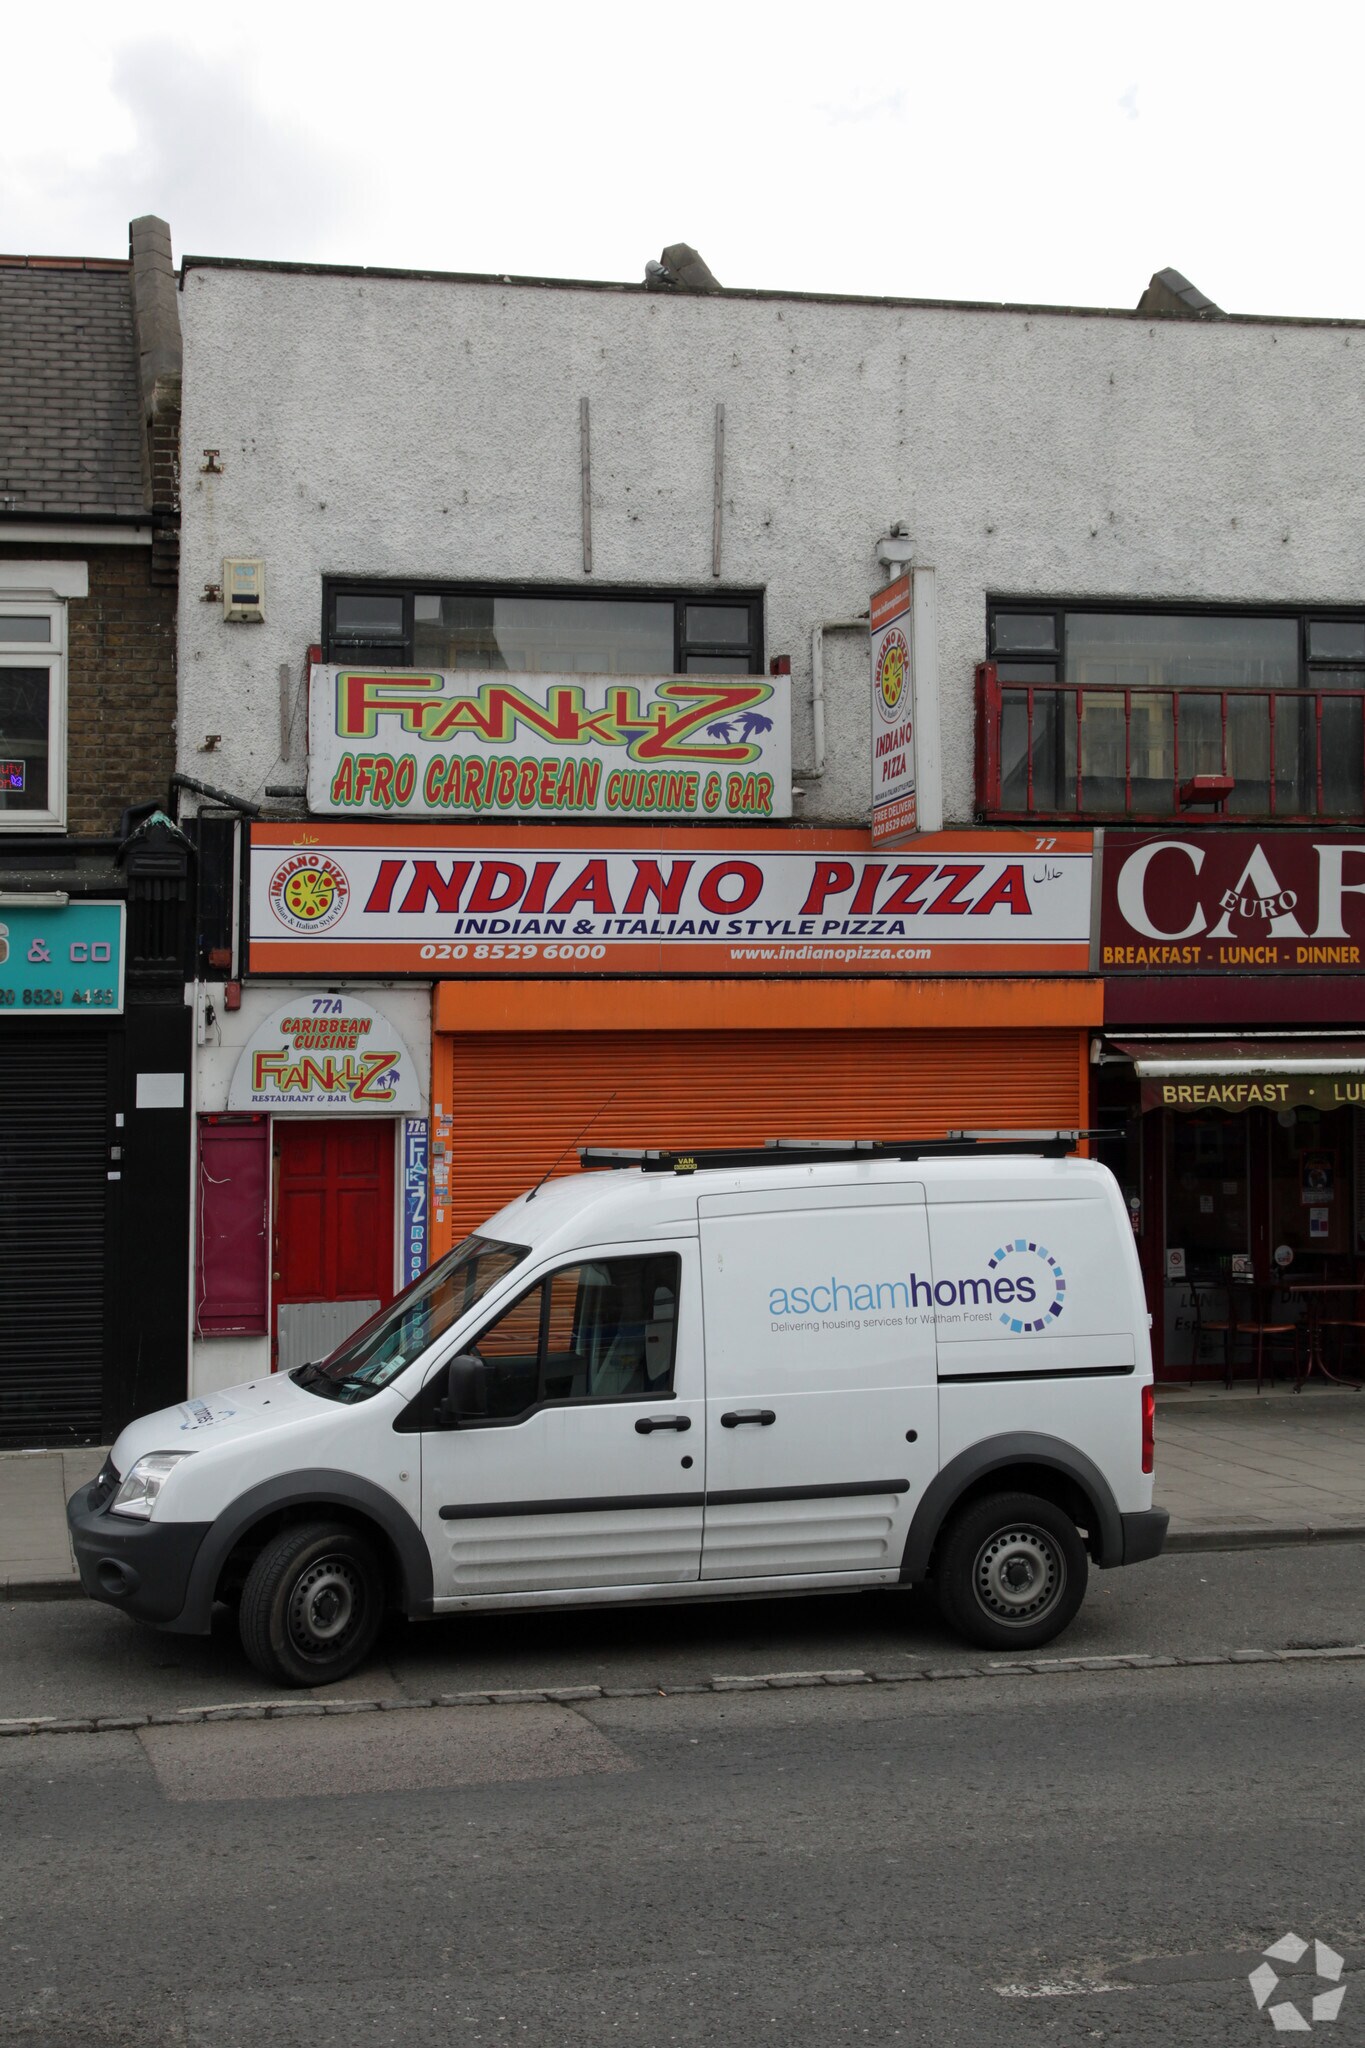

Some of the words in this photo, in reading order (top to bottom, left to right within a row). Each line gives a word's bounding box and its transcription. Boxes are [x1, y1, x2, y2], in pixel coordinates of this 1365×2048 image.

[875, 722, 912, 758] INDIANO
[882, 752, 907, 782] PIZZA
[331, 752, 417, 810] AFRO
[423, 754, 603, 812] CARIBBEAN
[605, 768, 700, 812] CUISINE
[703, 771, 721, 813] &
[726, 771, 774, 817] BAR
[873, 810, 888, 823] FREE
[888, 797, 916, 817] DELIVERY
[1033, 838, 1057, 850] 77
[271, 855, 319, 897] INDIANO
[322, 860, 348, 897] PIZZA
[363, 859, 764, 915] INDIANO
[798, 861, 1033, 915] PIZZA
[1219, 888, 1298, 918] EURO
[454, 918, 566, 935] INDIAN
[572, 919, 596, 935] &
[602, 919, 720, 935] ITALIAN
[725, 919, 814, 935] STYLE
[821, 920, 906, 935] PIZZA
[27, 939, 51, 962] &
[70, 942, 111, 962] CO
[419, 945, 468, 959] 020
[473, 945, 538, 960] 8529
[542, 945, 606, 960] 6000
[730, 945, 931, 963] www.indianopizza.com
[1103, 946, 1201, 964] BREAKFAST
[1220, 946, 1278, 963] LUNCH
[1296, 946, 1360, 963] DINNER
[23, 989, 63, 1005] 8529
[312, 999, 343, 1014] 77A
[280, 1017, 373, 1035] CARIBBEAN
[292, 1033, 359, 1050] CUISINE
[327, 1094, 347, 1102] BAR
[1163, 1084, 1289, 1103] BREAKFAST
[1334, 1083, 1365, 1101] LU
[408, 1120, 426, 1132] 77a
[769, 1273, 1036, 1316] aschamhomes
[771, 1321, 820, 1333] Delivering
[822, 1319, 861, 1330] housing
[863, 1317, 903, 1327] services
[905, 1315, 918, 1325] for
[963, 1312, 993, 1322] Forest
